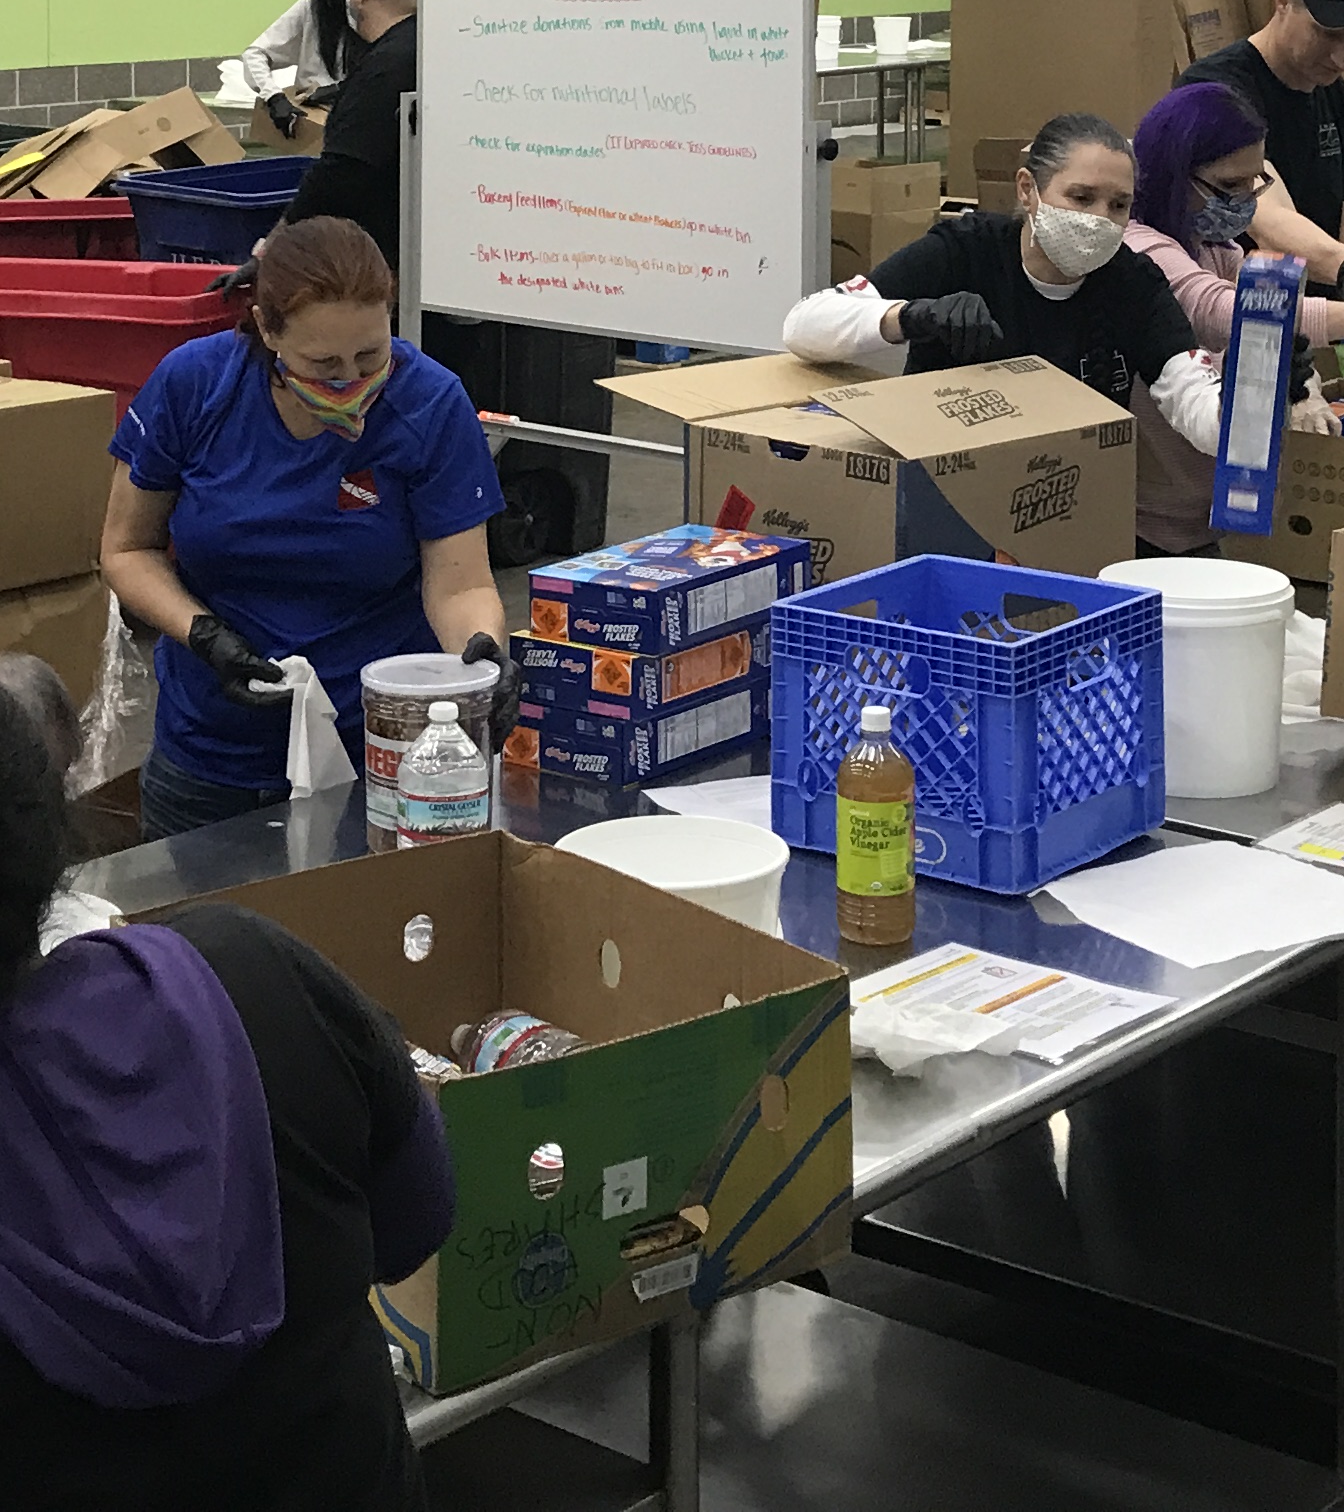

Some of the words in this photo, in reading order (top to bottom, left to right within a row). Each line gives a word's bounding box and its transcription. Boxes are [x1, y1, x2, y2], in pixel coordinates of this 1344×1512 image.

[473, 15, 529, 38] Sanitize
[533, 16, 593, 33] donations
[474, 79, 518, 104] Check
[523, 83, 546, 102] for
[551, 84, 639, 111] nutritional
[643, 86, 697, 115] labels
[940, 389, 1005, 418] FROSTED
[957, 401, 1016, 427] FLAKES
[847, 454, 889, 483] 18176
[1011, 465, 1080, 513] FROSTED
[762, 508, 810, 536] Kellogg's
[1014, 488, 1074, 533] FLAKES
[602, 623, 640, 635] FROSTED
[605, 632, 637, 643] FLAKES
[572, 753, 609, 765] FROSTED
[574, 761, 606, 773] FLAKES
[850, 815, 889, 828] Organic
[850, 826, 879, 840] Apple
[882, 826, 907, 838] Cider
[850, 836, 891, 852] Vinegar
